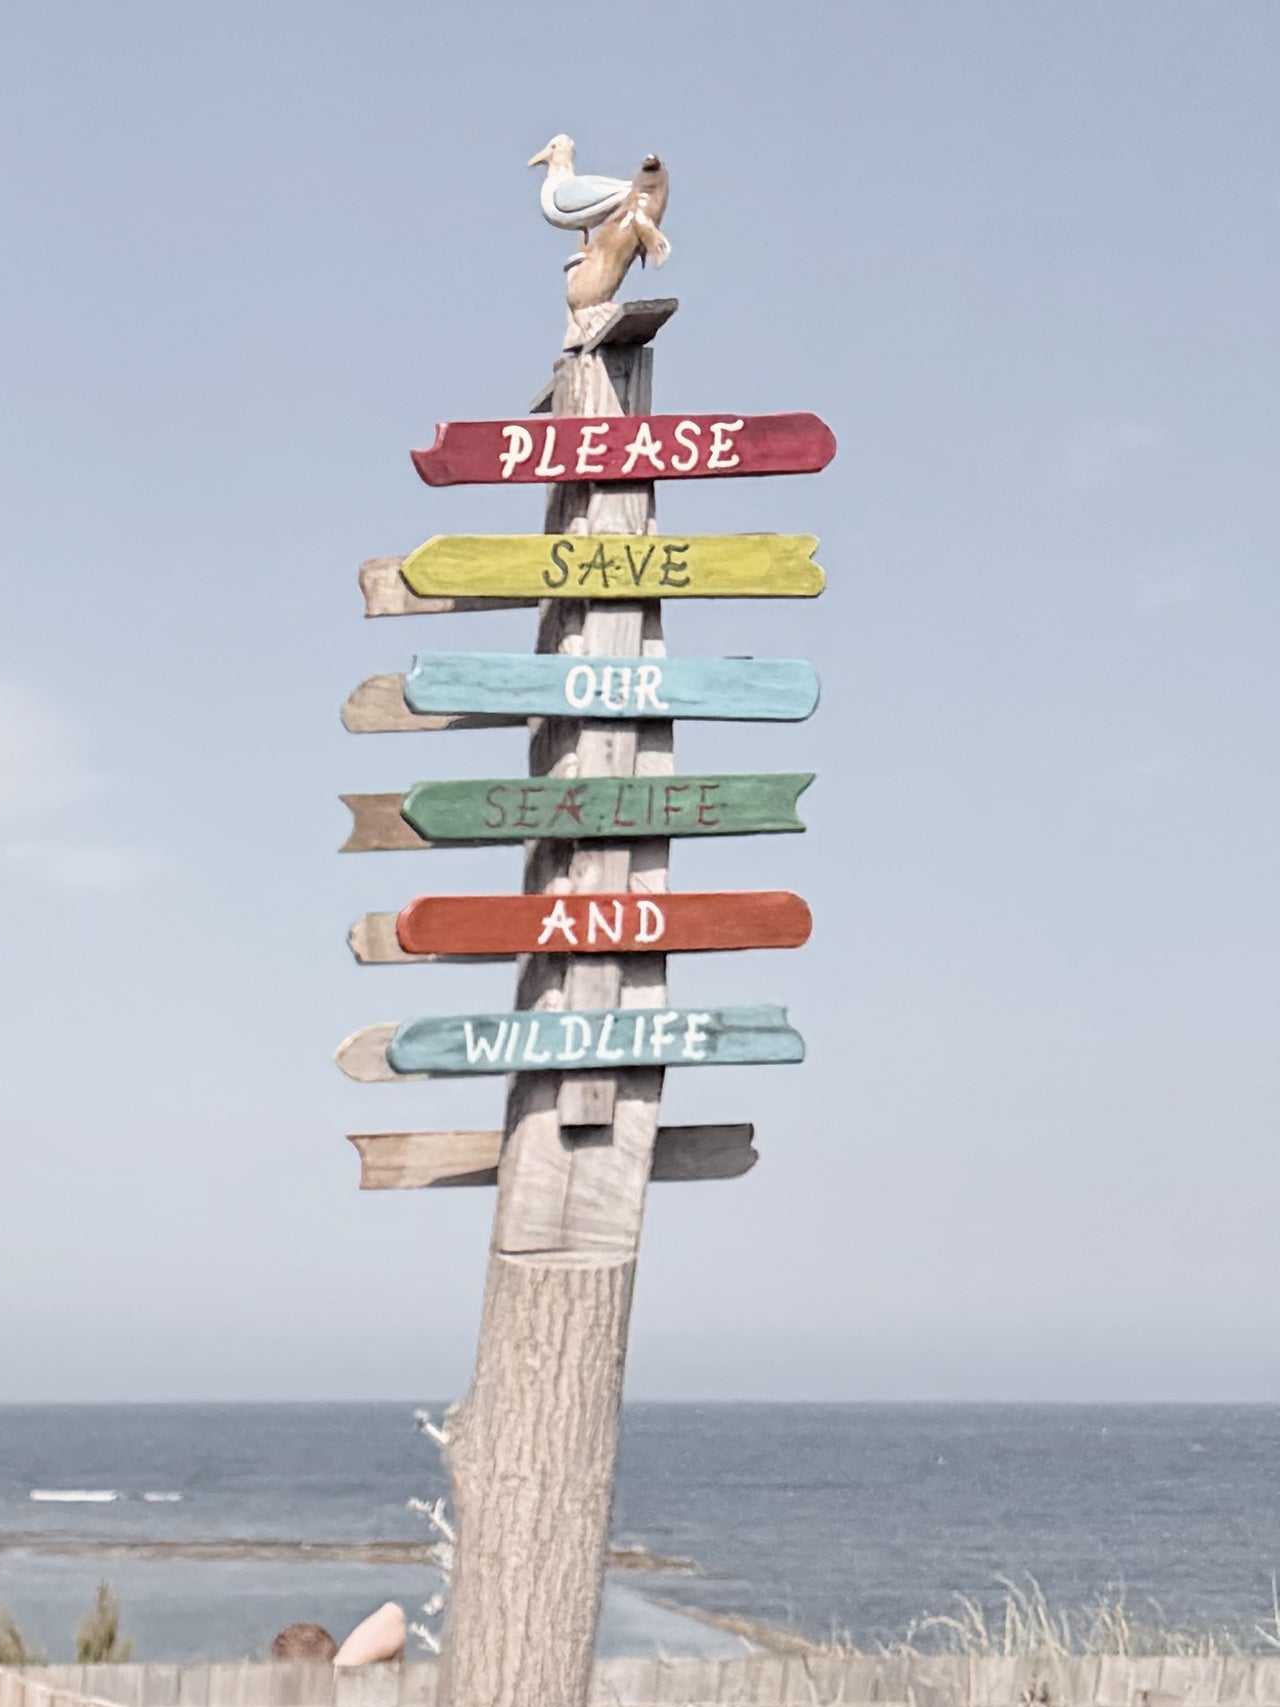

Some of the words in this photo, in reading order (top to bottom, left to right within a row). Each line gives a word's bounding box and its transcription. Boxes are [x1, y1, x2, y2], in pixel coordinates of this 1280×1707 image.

[499, 419, 745, 478] PLEASE
[542, 540, 691, 589] SAVE
[564, 664, 669, 711] OUR
[484, 783, 584, 829] SEA
[611, 783, 721, 828] LIFE
[536, 899, 666, 945] AND
[463, 1011, 712, 1064] WILDLIFE
